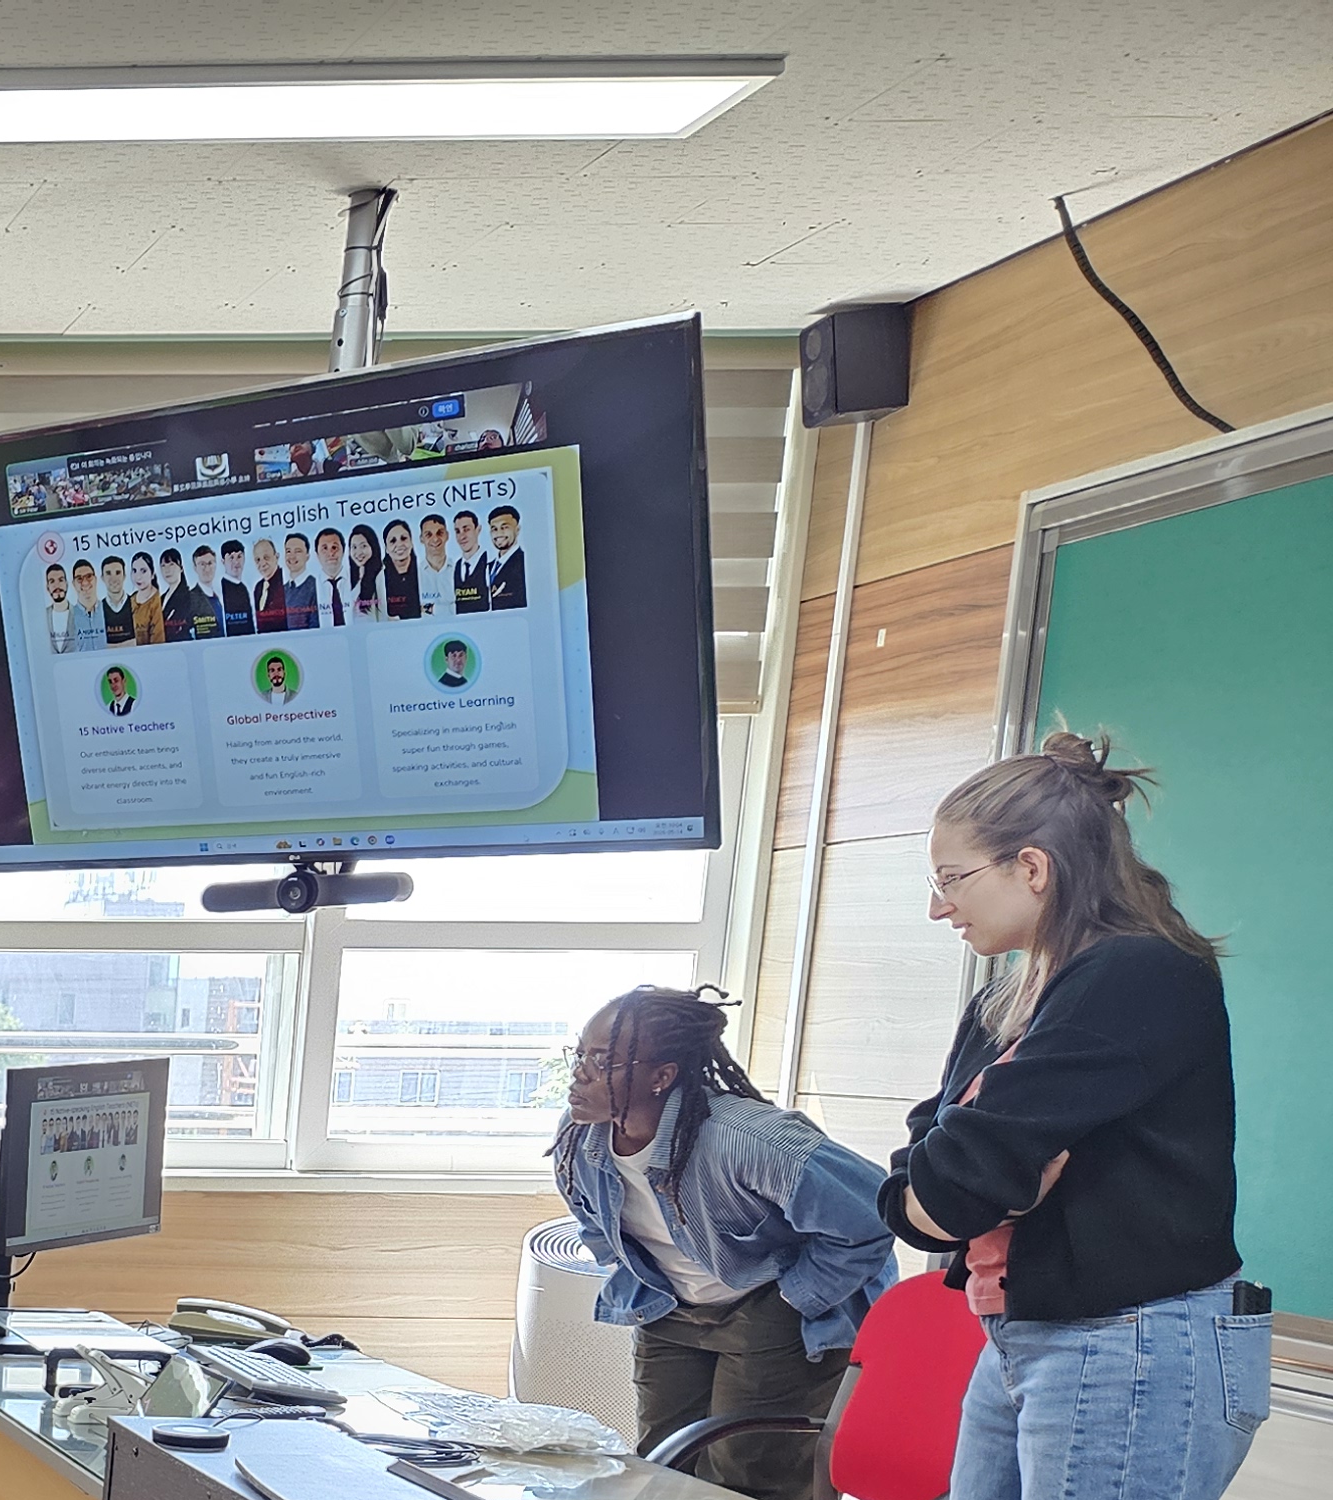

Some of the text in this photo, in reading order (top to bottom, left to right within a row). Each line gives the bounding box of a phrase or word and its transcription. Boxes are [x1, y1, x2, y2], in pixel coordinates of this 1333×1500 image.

[72, 478, 516, 552] 15 Native-speaking English Teachers (NETs)
[389, 694, 515, 713] Interactive Learning
[226, 709, 337, 725] Global Perspectives
[78, 721, 175, 736] 15 Native Teachers
[391, 721, 517, 738] Specializing in making English
[254, 739, 273, 747] from
[274, 737, 302, 745] around
[303, 735, 315, 743] the
[401, 745, 425, 754] super
[426, 744, 441, 753] fun
[442, 742, 476, 752] through
[80, 751, 93, 759] Our
[231, 757, 248, 765] they
[249, 756, 273, 764] create
[300, 752, 342, 761] immersive
[169, 760, 183, 769] and
[392, 762, 429, 773] speaking
[471, 759, 488, 767] and
[489, 757, 523, 767] cultural
[174, 777, 188, 785] the
[249, 772, 264, 780] and
